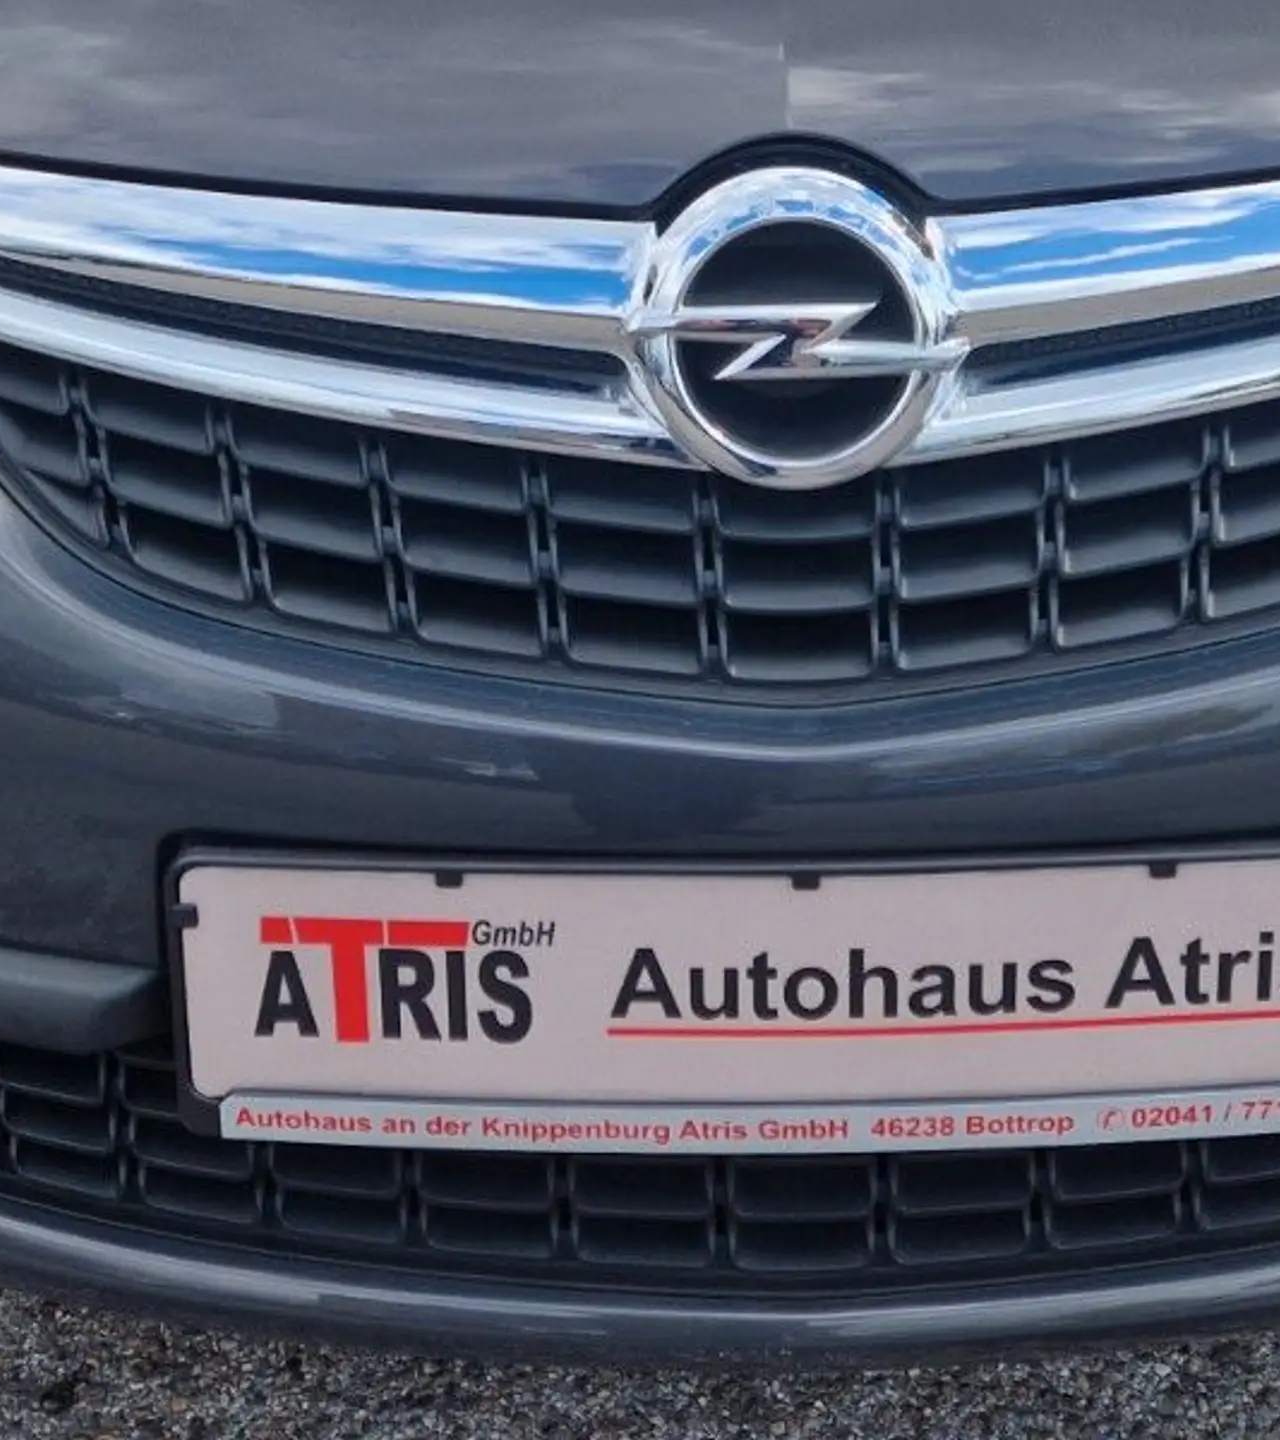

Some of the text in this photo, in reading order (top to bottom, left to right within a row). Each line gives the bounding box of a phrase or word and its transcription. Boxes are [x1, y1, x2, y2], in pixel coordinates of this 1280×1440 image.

[254, 916, 556, 1044] ATRIS GmbH
[611, 947, 1076, 1020] Autohaus
[235, 1107, 373, 1133] Autohaus
[381, 1116, 416, 1134] an
[425, 1115, 472, 1137] der
[481, 1116, 670, 1145] Knippenburg
[678, 1119, 748, 1140] Atris
[758, 1118, 849, 1141] GmbH
[870, 1116, 955, 1138] 46238
[965, 1112, 1075, 1137] Bottrop
[1131, 1104, 1213, 1129] 02041
